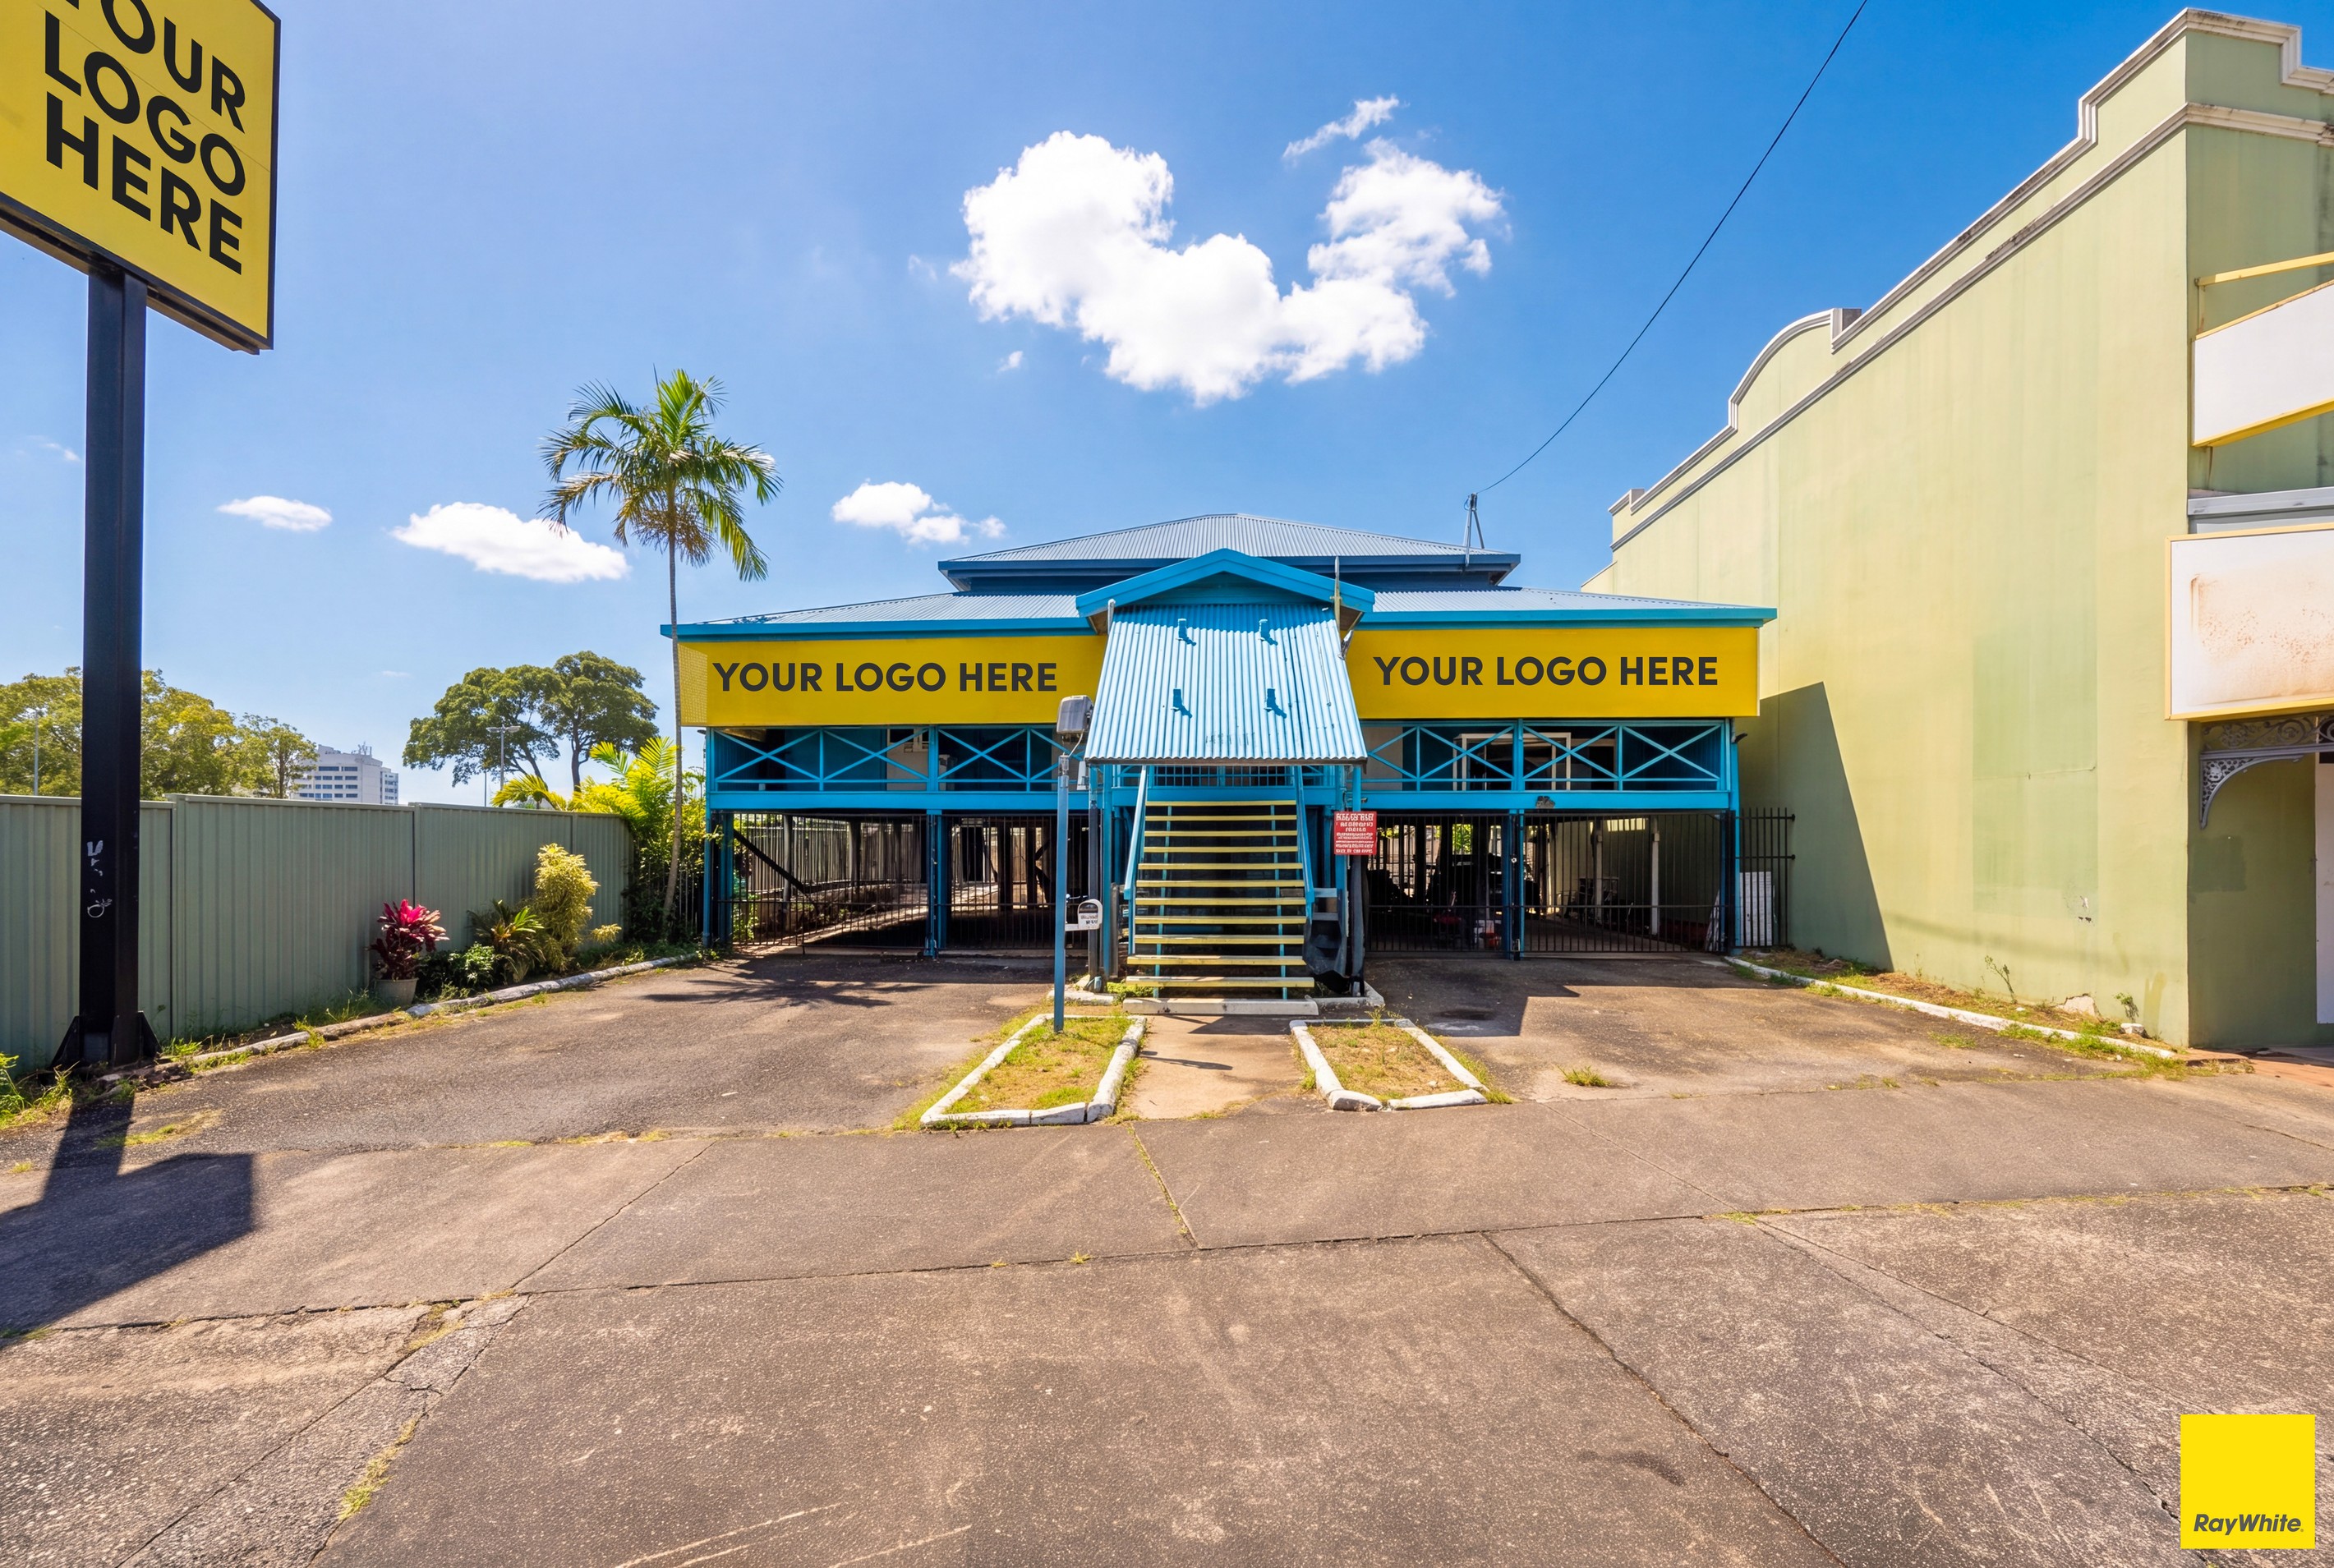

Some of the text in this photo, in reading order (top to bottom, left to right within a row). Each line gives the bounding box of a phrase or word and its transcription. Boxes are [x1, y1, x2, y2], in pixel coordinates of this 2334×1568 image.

[44, 10, 246, 196] LOGO
[65, 0, 246, 134] OUR
[46, 91, 242, 275] HERE
[711, 662, 1057, 692] YOUR LOGO HERE
[1373, 656, 1718, 686] YOUR LOGO HERE
